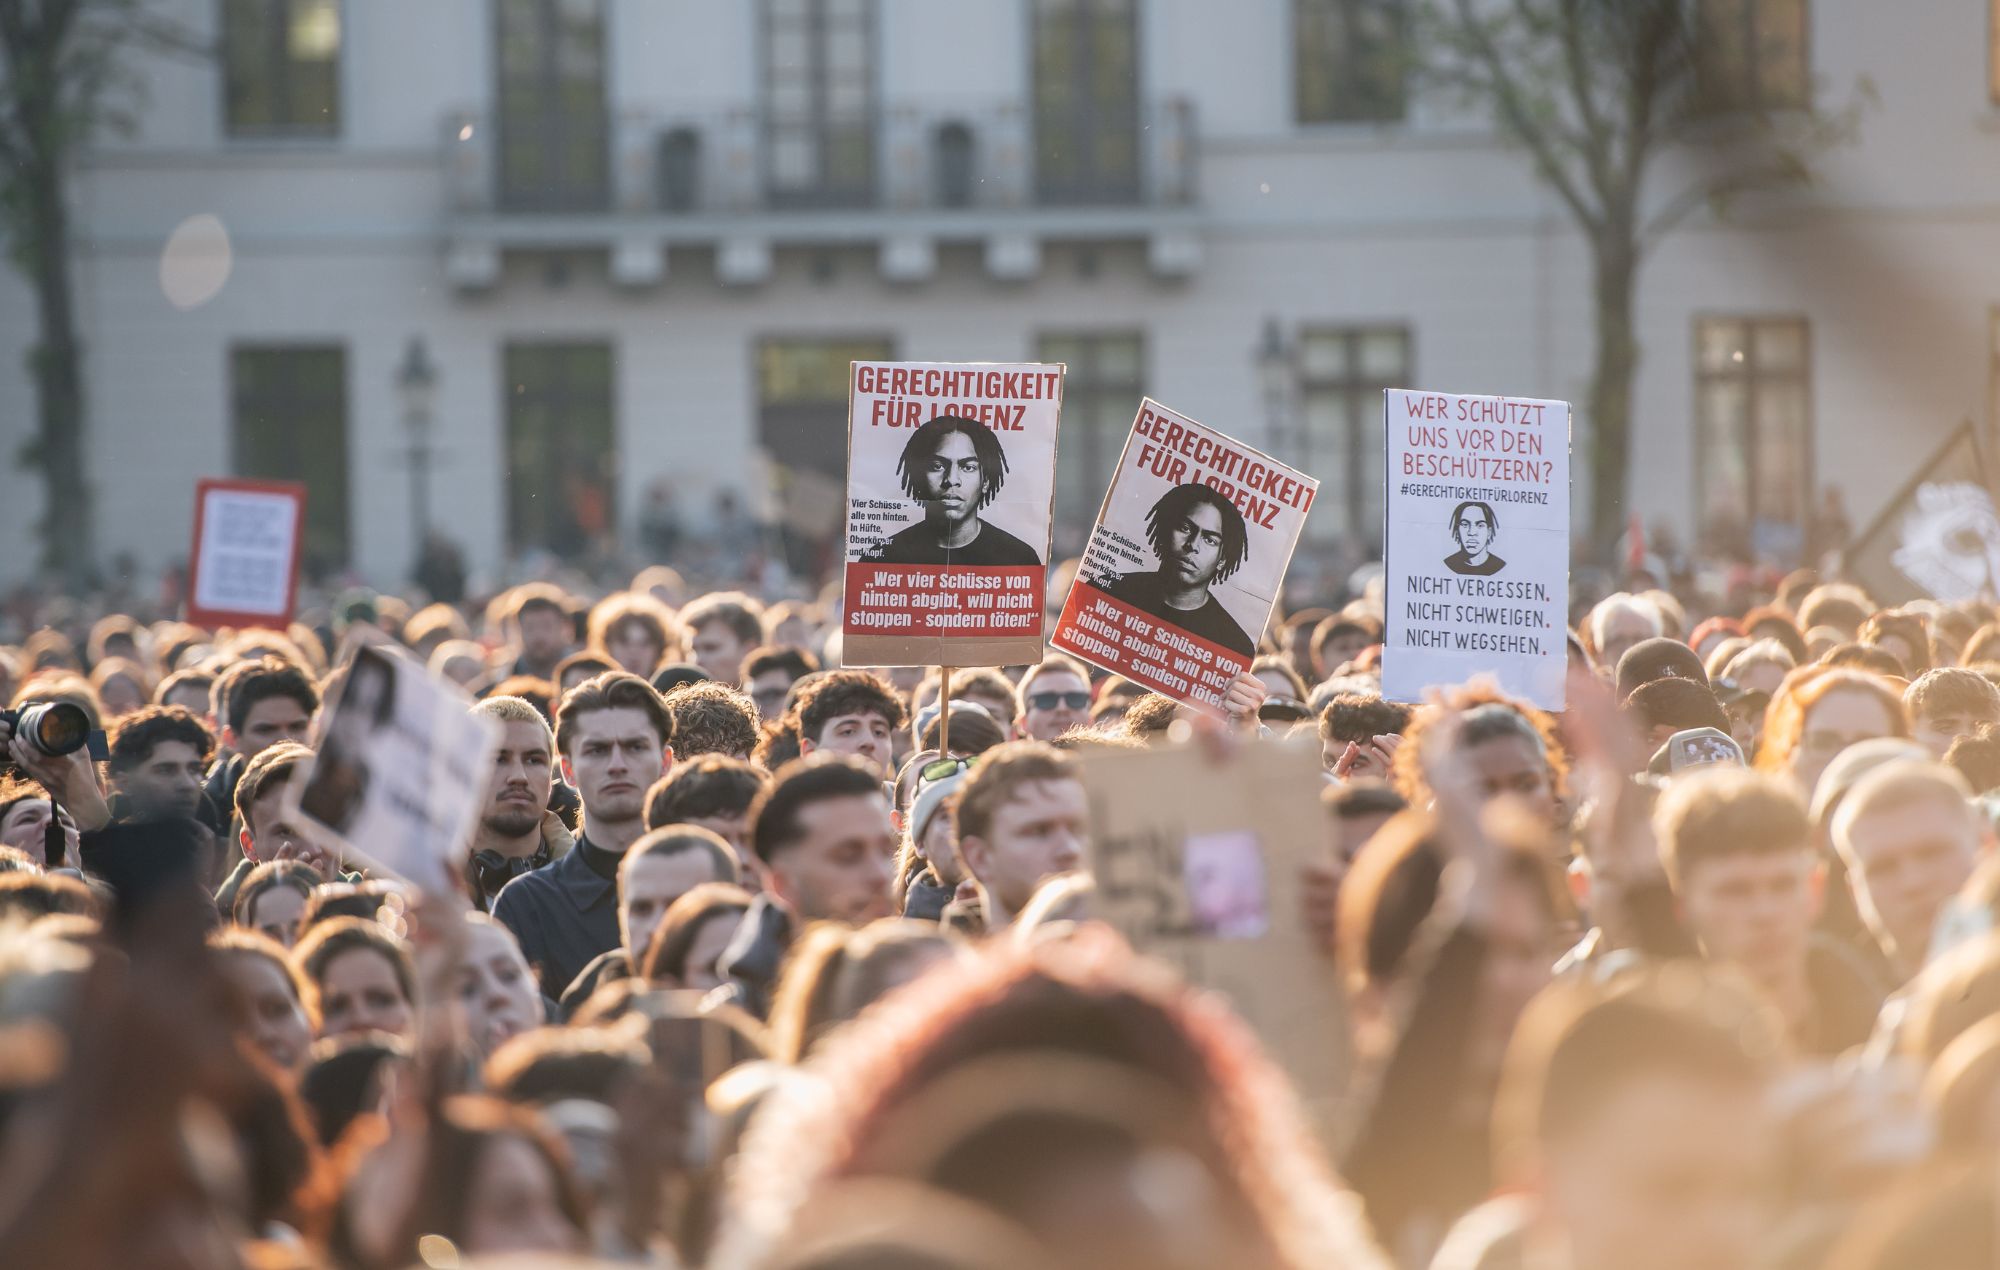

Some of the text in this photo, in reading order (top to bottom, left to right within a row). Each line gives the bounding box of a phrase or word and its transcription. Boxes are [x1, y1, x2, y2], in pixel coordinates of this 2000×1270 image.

[858, 366, 1058, 399] GERECHTIGKEIT
[872, 396, 922, 428] FÜR
[1405, 395, 1546, 426] WER SCHÜTZT
[1408, 426, 1542, 455] UNS VOR DEN
[1135, 408, 1316, 513] GERECHTIGKEIT
[1137, 443, 1187, 486] FÜR
[1403, 452, 1553, 484] BESCHÜTZERN?
[851, 499, 867, 508] Vier
[869, 500, 901, 509] Schüsse
[1400, 483, 1548, 505] #GERECHTIGKEITFÜRLORENZ
[850, 523, 882, 534] In Hüfte,
[851, 511, 909, 522] alle von hinten.
[849, 548, 863, 556] und
[850, 535, 893, 546] Oberkörper
[1092, 537, 1144, 566] alle von hinten.
[1096, 525, 1111, 538] Vier
[1111, 532, 1141, 552] Schüsse
[1084, 556, 1124, 581] Oberkörper
[1087, 546, 1117, 567] In Hüfte,
[865, 572, 1030, 589] „Wer vier Schüsse von
[1080, 569, 1094, 579] und
[860, 591, 1033, 610] hinten abgibt, will nicht
[1407, 575, 1550, 602] NICHT VERGESSEN.
[851, 611, 911, 629] stoppen
[925, 612, 985, 628] sondern
[1407, 602, 1551, 628] NICHT SCHWEIGEN.
[1076, 611, 1121, 643] hinten
[1123, 635, 1169, 666] abgibt,
[1173, 656, 1200, 679] will
[1125, 614, 1153, 636] vier
[1154, 627, 1213, 664] Schüsse
[1215, 655, 1243, 675] von
[1406, 628, 1547, 656] NICHT WEGSEHEN.
[1062, 627, 1119, 663] stoppen
[1131, 658, 1188, 693] sondern
